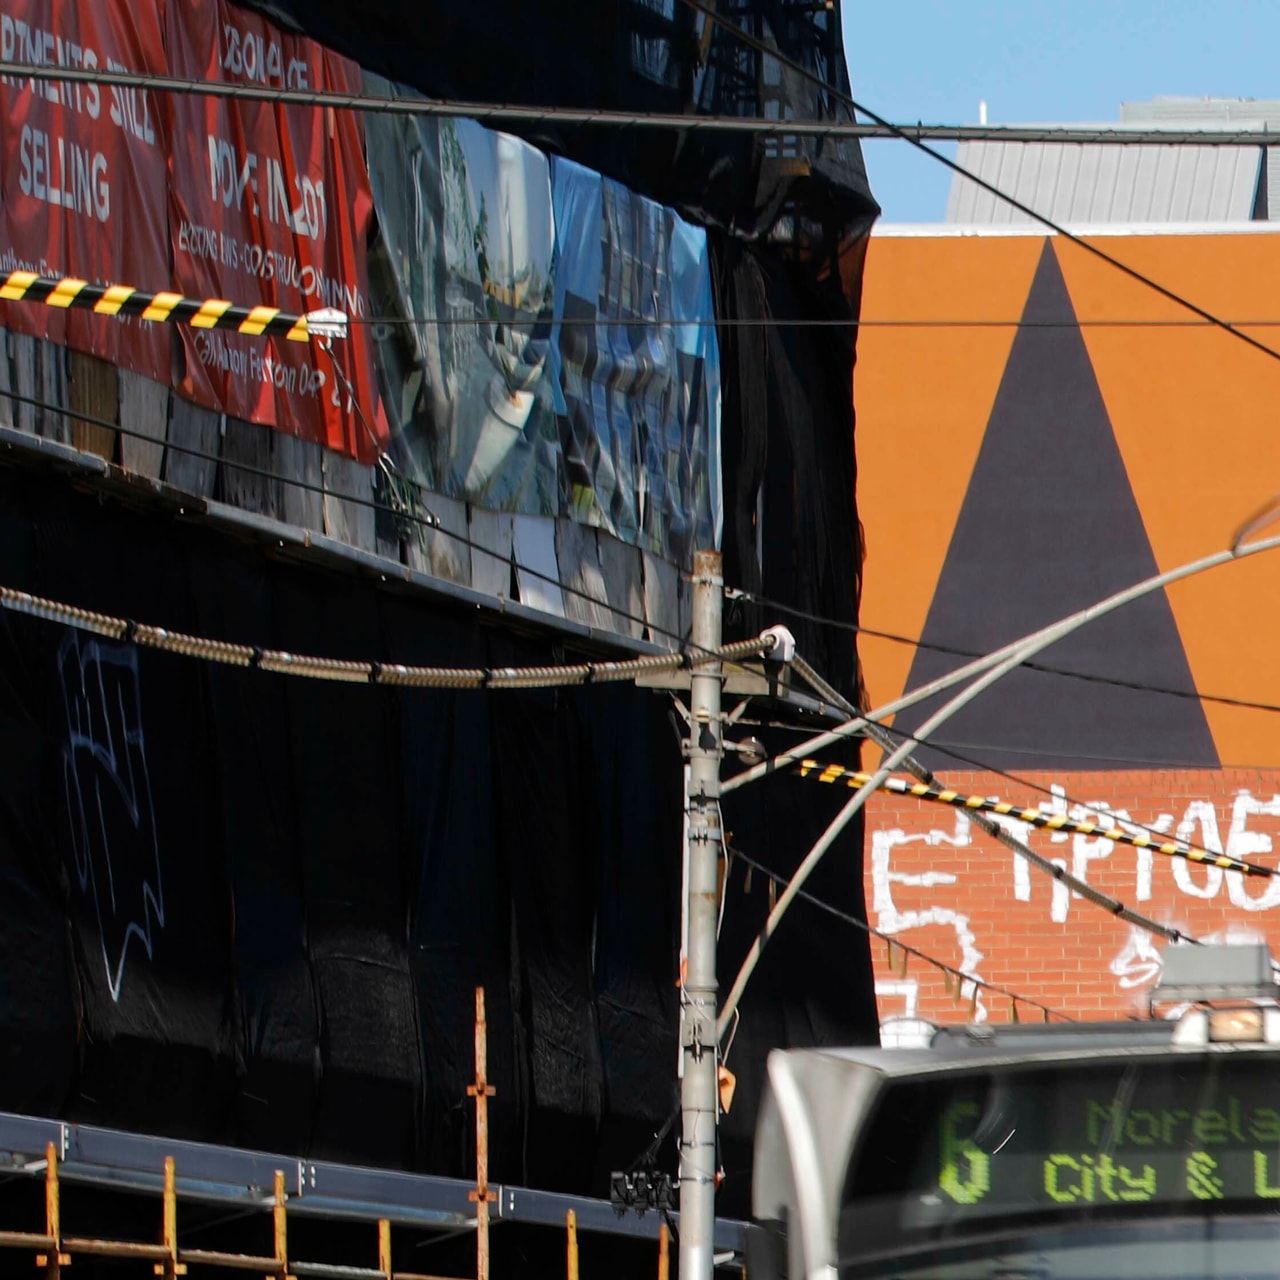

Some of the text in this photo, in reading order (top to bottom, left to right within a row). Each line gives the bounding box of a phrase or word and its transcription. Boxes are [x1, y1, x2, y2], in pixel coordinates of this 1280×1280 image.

[19, 122, 110, 223] SELLING
[939, 1102, 991, 1204] 6
[1043, 1152, 1156, 1203] City
[1186, 1150, 1224, 1201] &
